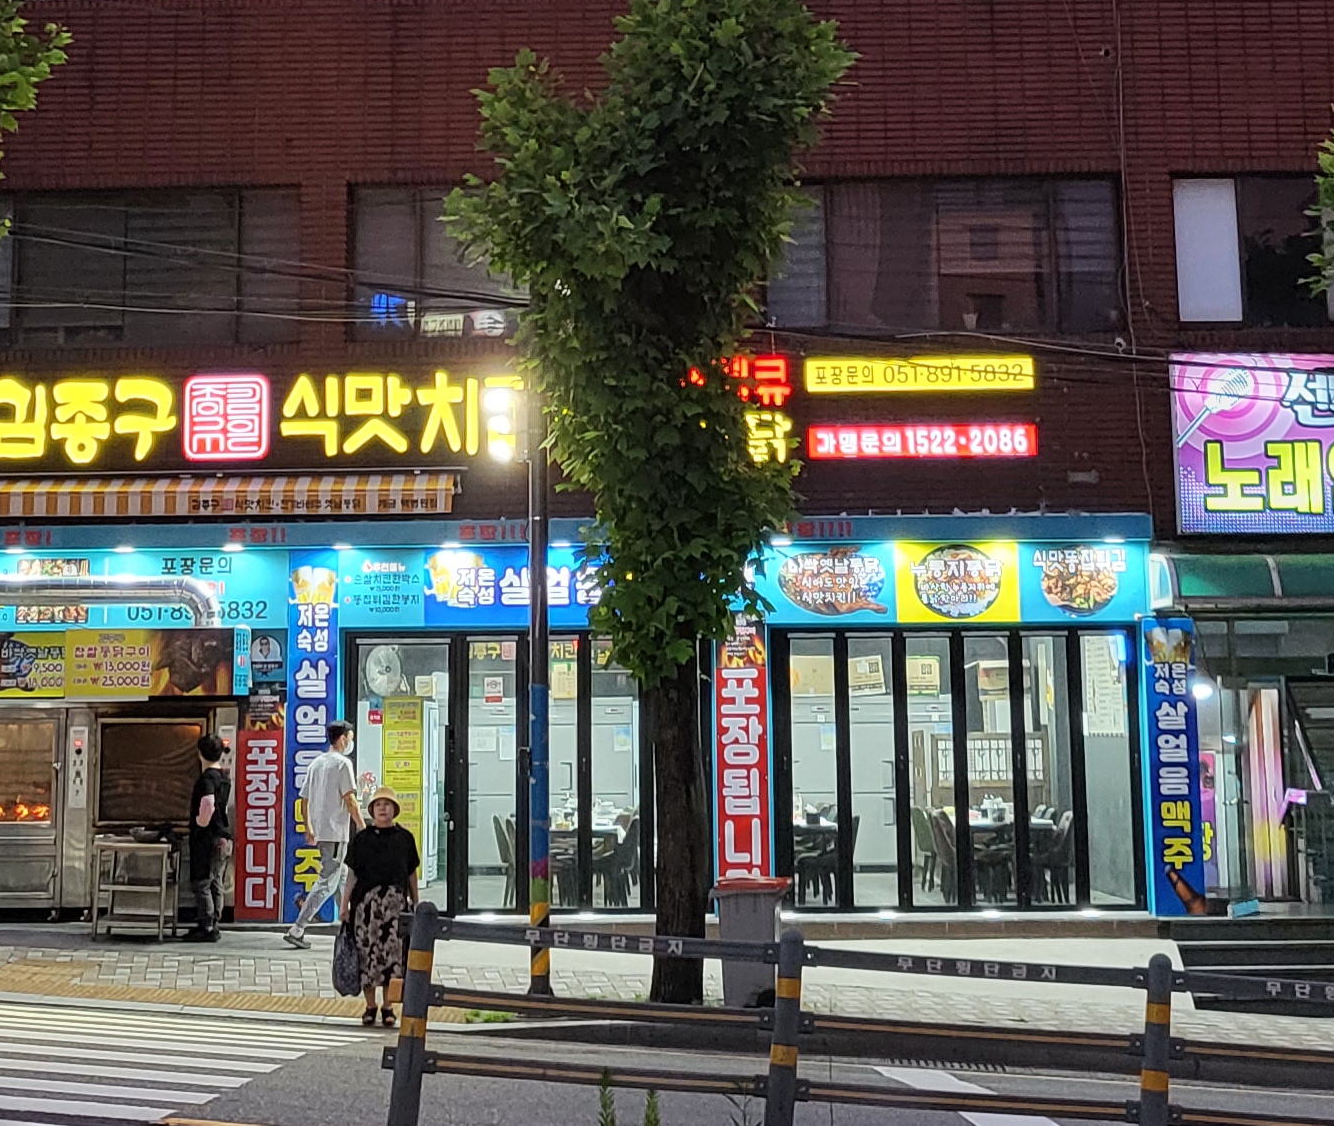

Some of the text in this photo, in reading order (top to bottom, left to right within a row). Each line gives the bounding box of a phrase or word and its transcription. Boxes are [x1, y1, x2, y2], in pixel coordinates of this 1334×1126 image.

[814, 365, 875, 386] 포장문의
[815, 430, 902, 455] 가맹문의
[161, 556, 233, 575] 포장문의
[909, 559, 1003, 578] 누룽지통닭
[720, 667, 763, 877] 포장됩니
[244, 738, 280, 910] 포장됩니다
